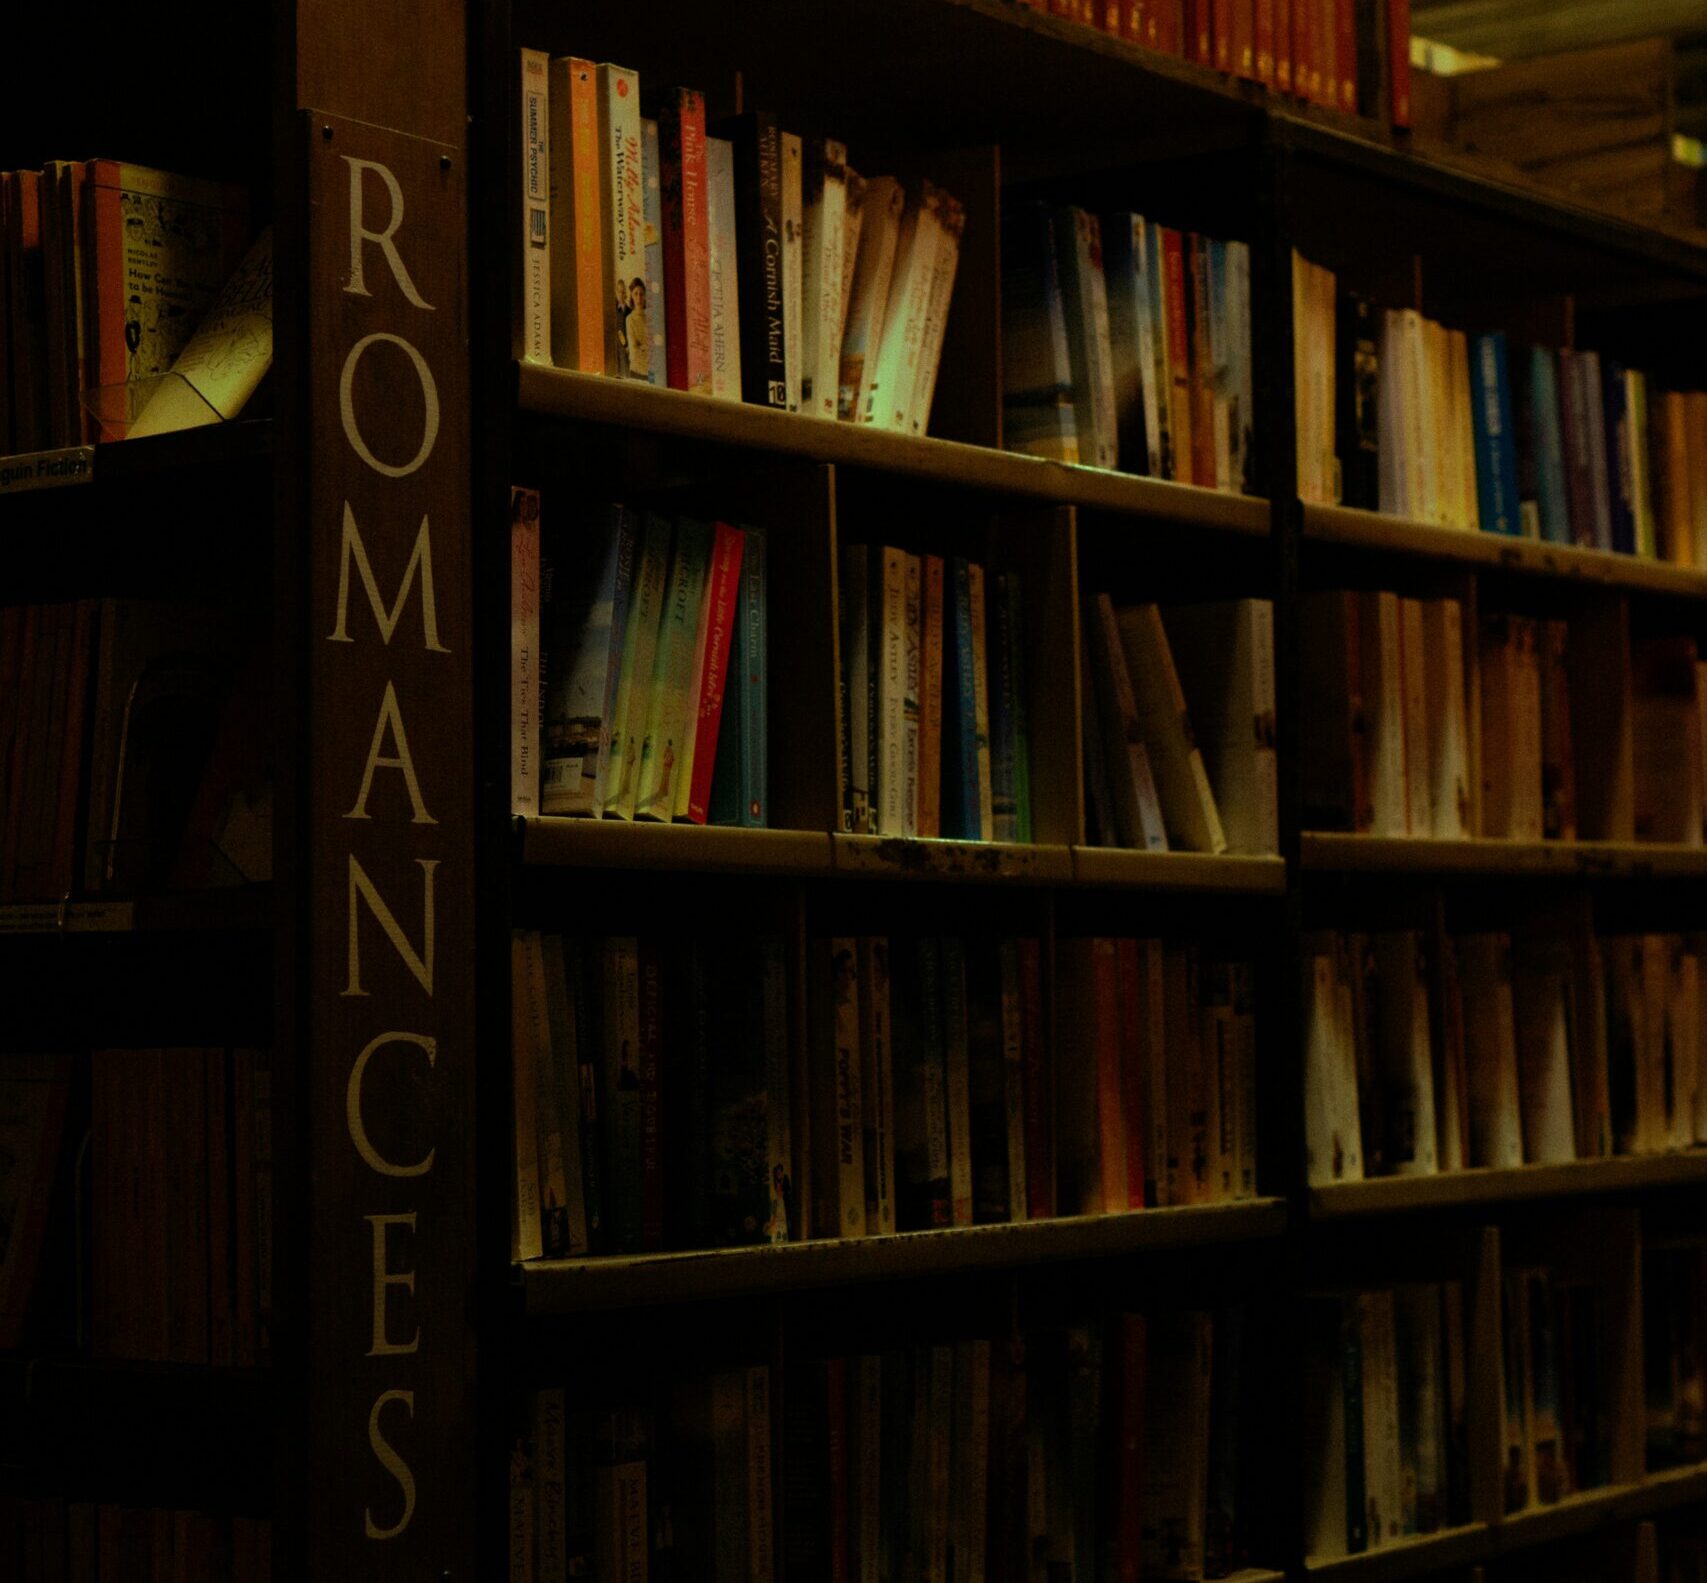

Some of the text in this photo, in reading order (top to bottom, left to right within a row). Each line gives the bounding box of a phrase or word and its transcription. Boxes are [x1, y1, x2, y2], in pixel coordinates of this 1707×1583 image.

[529, 96, 540, 194] SUMMER PSYCHIC
[614, 126, 628, 261] The Waterway Girls
[624, 137, 642, 256] Milly Adams
[684, 124, 699, 226] Pink House
[128, 268, 151, 280] How
[129, 281, 140, 291] to
[142, 283, 153, 293] be
[764, 239, 781, 312] Cornish
[532, 259, 543, 358] JESSICA ADAMS
[713, 320, 725, 374] AHERN
[767, 316, 784, 364] Maid
[0, 456, 88, 486] guin Fiction
[749, 608, 762, 658] Charm
[889, 588, 900, 626] JUDY
[520, 647, 529, 666] The
[710, 626, 724, 671] Cornish
[889, 632, 900, 686] ASTLEY
[520, 709, 529, 741] That
[520, 745, 529, 776] Bind
[326, 154, 452, 1539] ROMANCES
[839, 1047, 853, 1165] POPPY'S WAR
[544, 1480, 562, 1561] Binchy
